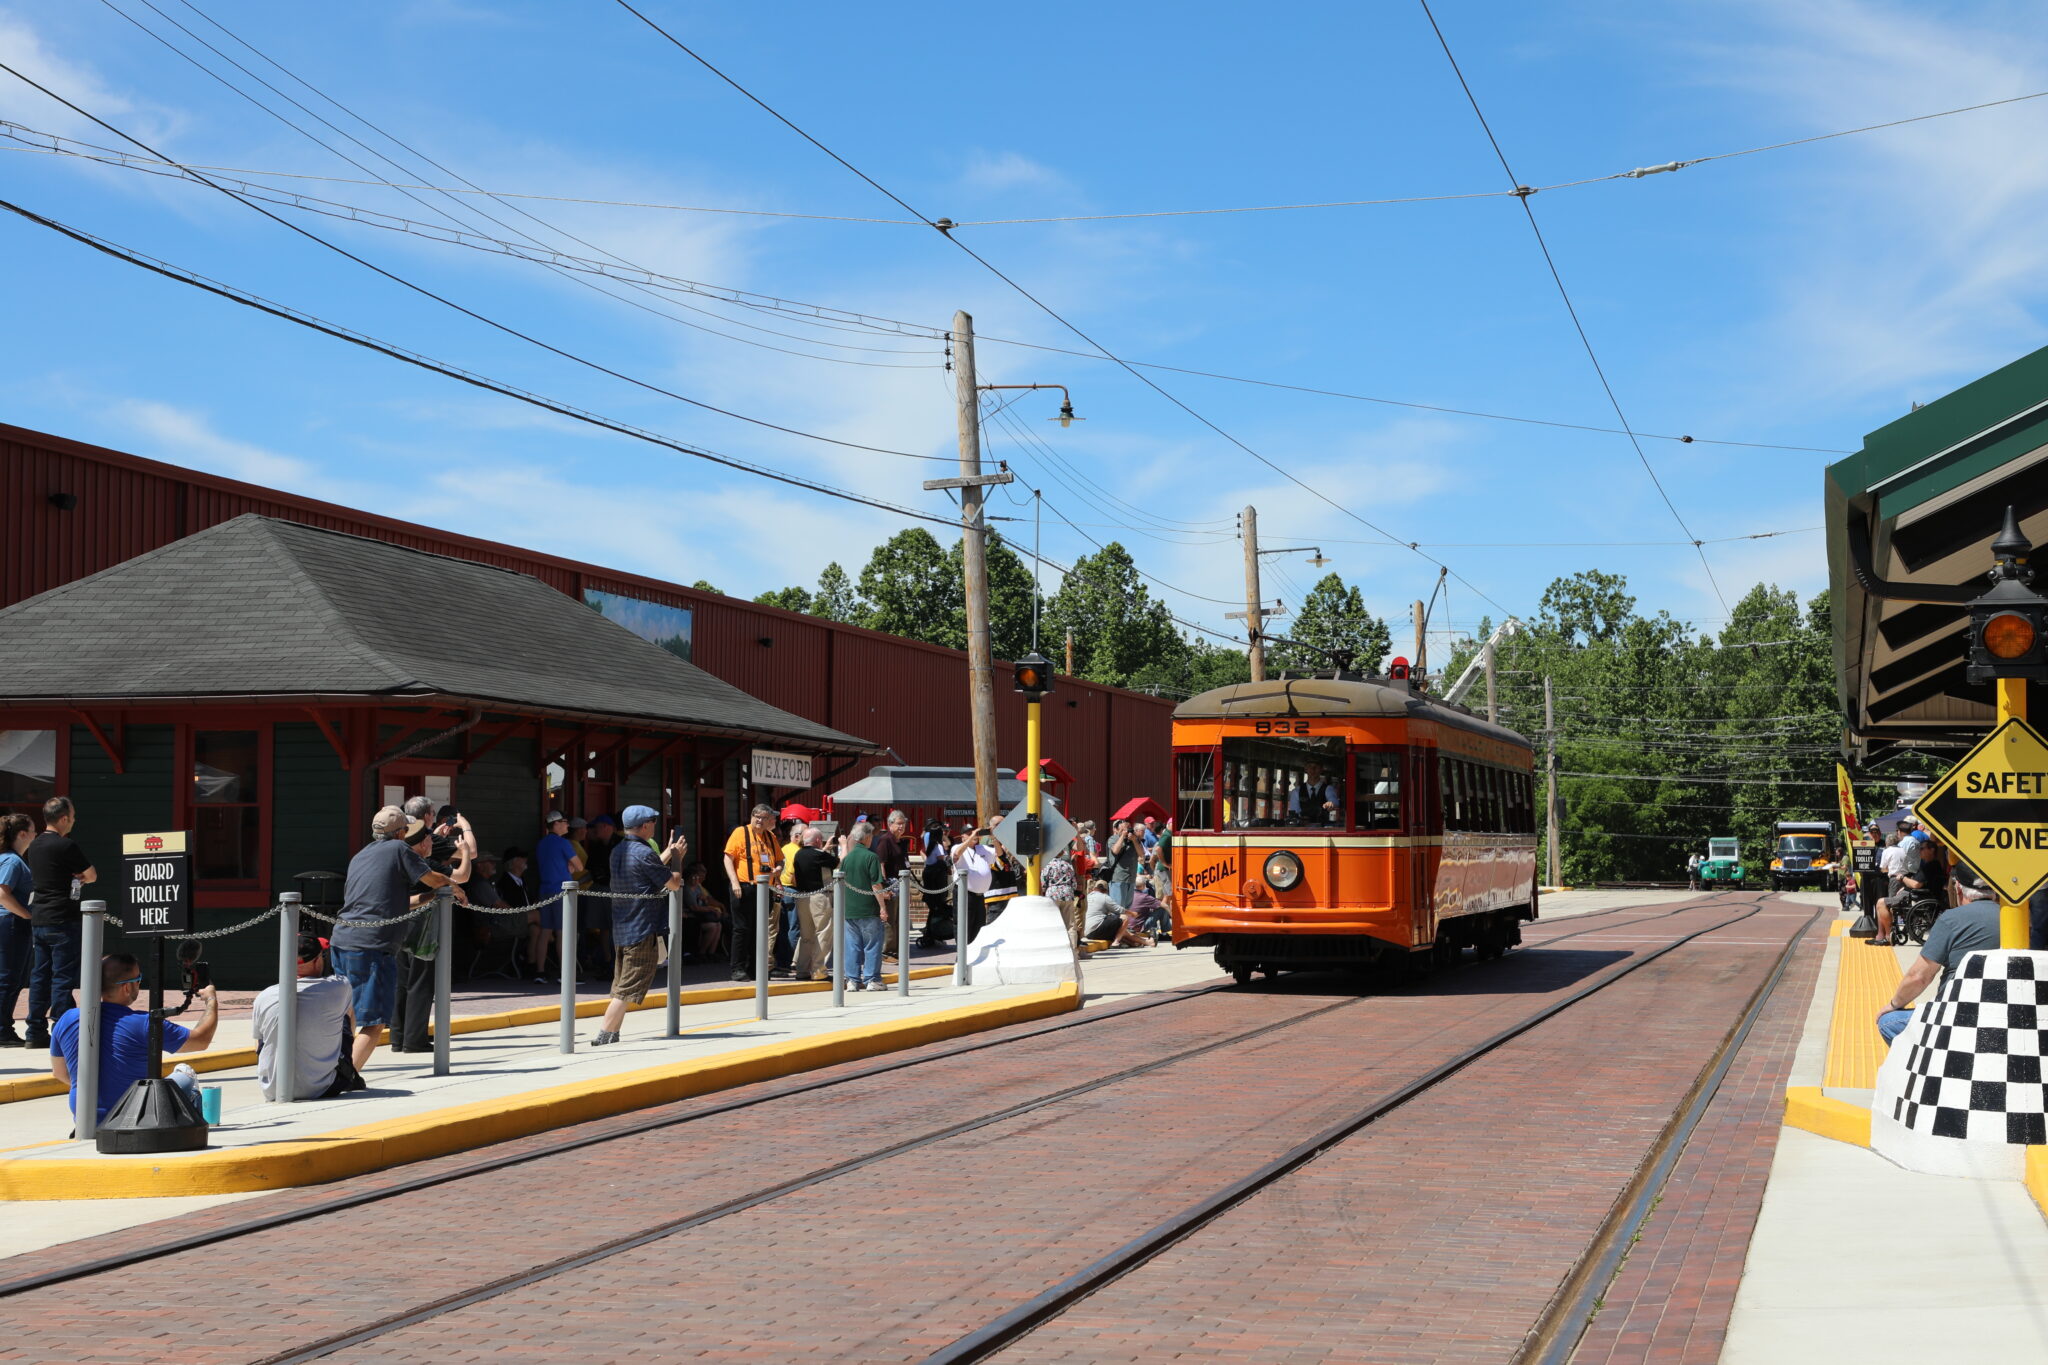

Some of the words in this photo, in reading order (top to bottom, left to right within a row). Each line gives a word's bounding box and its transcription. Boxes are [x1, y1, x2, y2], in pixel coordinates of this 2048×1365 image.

[1255, 721, 1310, 734] 832
[752, 754, 811, 782] WEXFORD
[1966, 771, 2048, 794] SAFET
[1979, 827, 2048, 850] ZONE
[134, 862, 174, 882] BOARD
[1185, 856, 1237, 895] SPECIAL
[129, 884, 180, 904] TROLLEY
[140, 907, 170, 926] HERE
